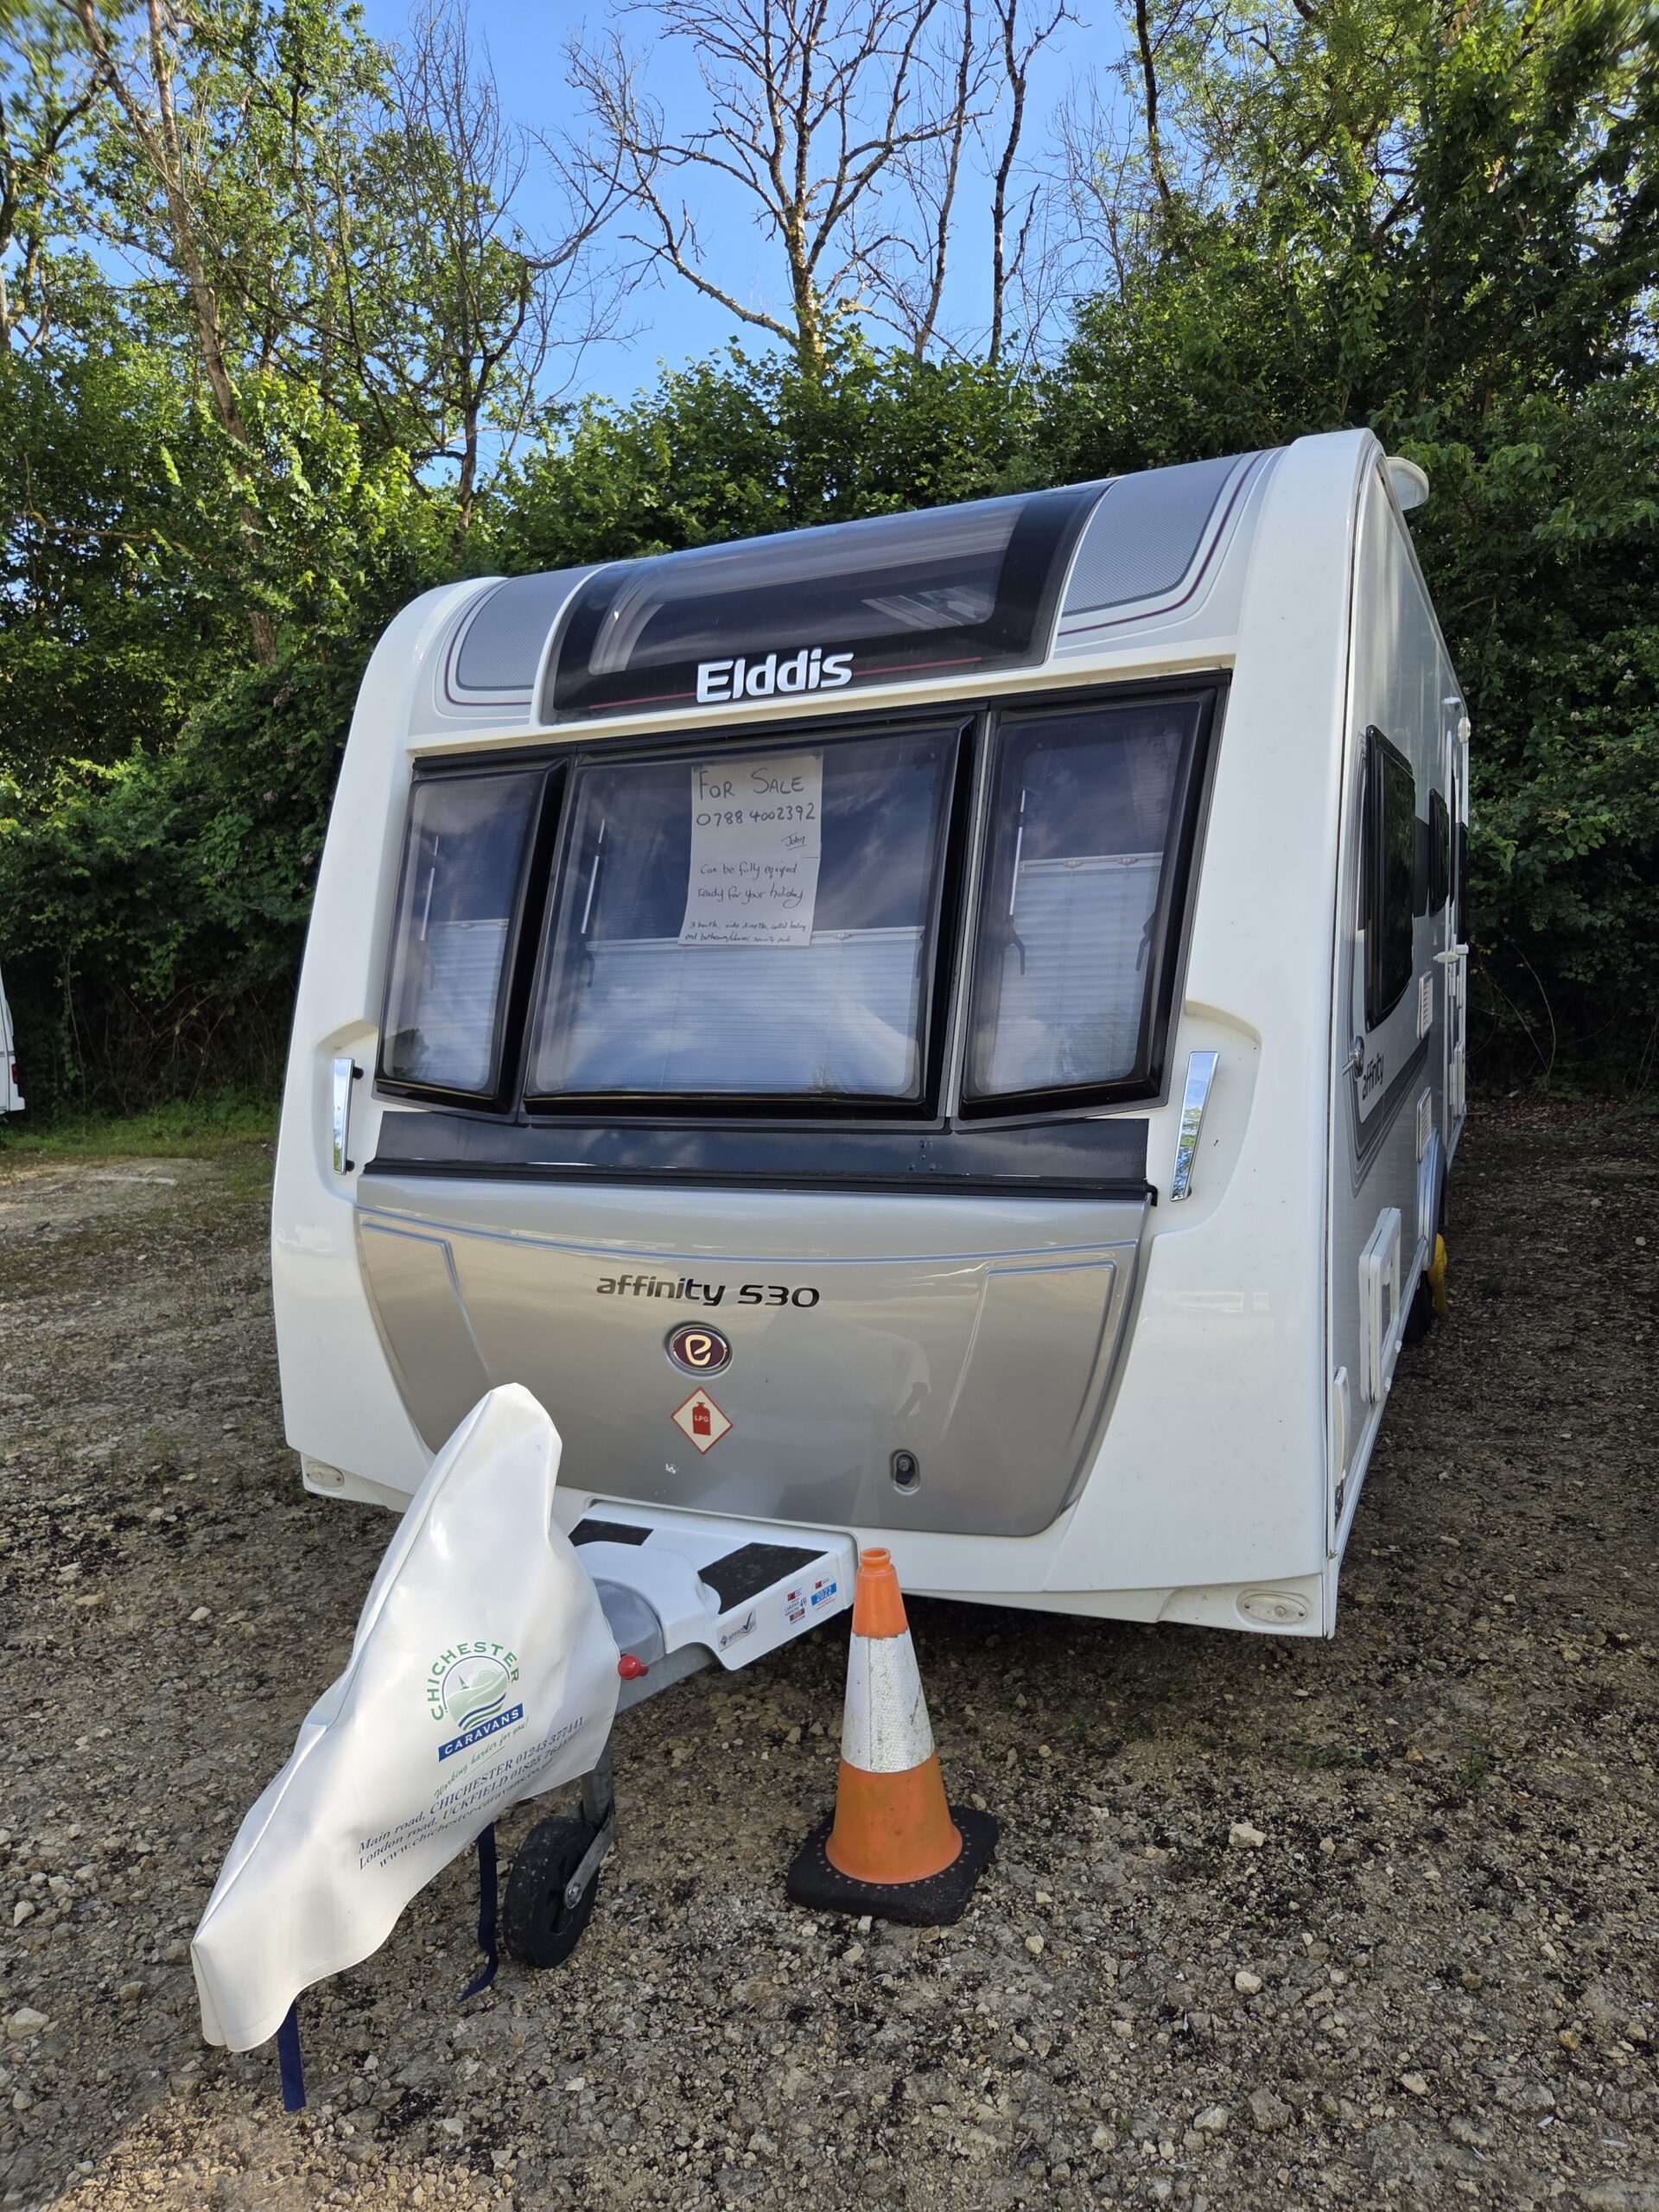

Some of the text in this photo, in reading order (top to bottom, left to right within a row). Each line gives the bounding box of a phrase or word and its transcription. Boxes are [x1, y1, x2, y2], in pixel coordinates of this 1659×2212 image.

[696, 646, 854, 703] Elddis
[698, 768, 804, 800] FOR SALE
[723, 862, 734, 874] be
[740, 861, 760, 880] fully
[728, 886, 741, 900] for
[742, 889, 766, 905] your
[596, 1274, 820, 1308] affinity 530
[694, 1414, 709, 1423] LPG
[427, 1641, 519, 1720] CHICHESTER
[445, 1709, 519, 1755] CARAVANS
[434, 1764, 468, 1799] Working
[471, 1740, 497, 1764] harder
[358, 1831, 391, 1854] Main
[394, 1810, 426, 1834] road,
[430, 1759, 513, 1815] CHICHESTER
[359, 1835, 404, 1871] London
[407, 1816, 438, 1839] road,
[442, 1776, 508, 1820] UCKFIELD
